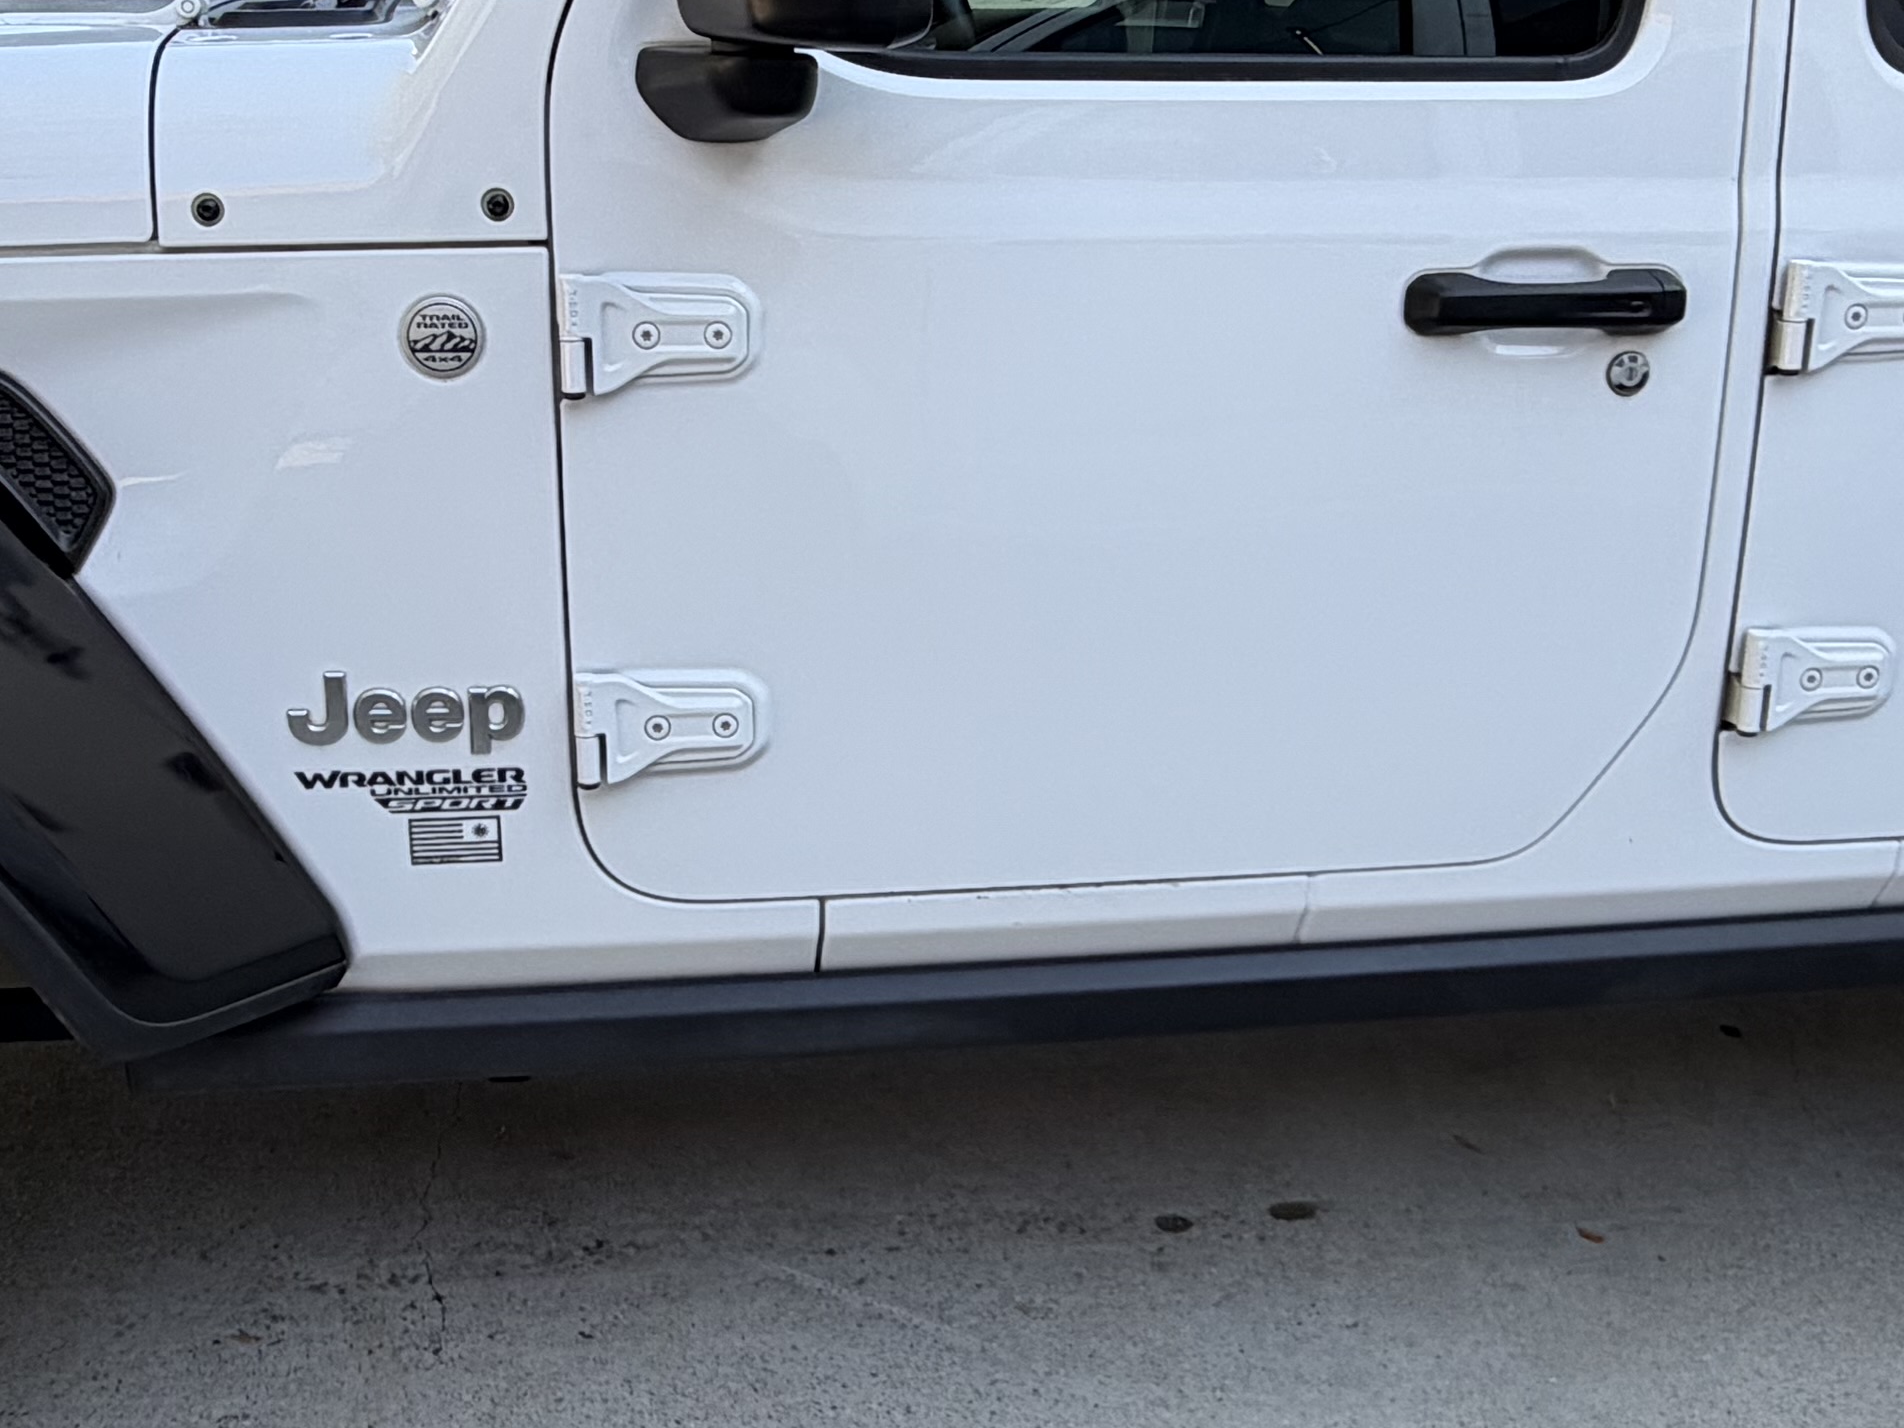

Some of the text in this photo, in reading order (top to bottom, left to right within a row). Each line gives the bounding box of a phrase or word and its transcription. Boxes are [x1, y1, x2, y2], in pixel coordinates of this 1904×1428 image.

[419, 314, 465, 322] TRAIL
[286, 670, 526, 755] Jeep
[294, 767, 527, 790] WRANGLER
[369, 784, 528, 797] UNLIMITED
[386, 797, 520, 811] SPORT
